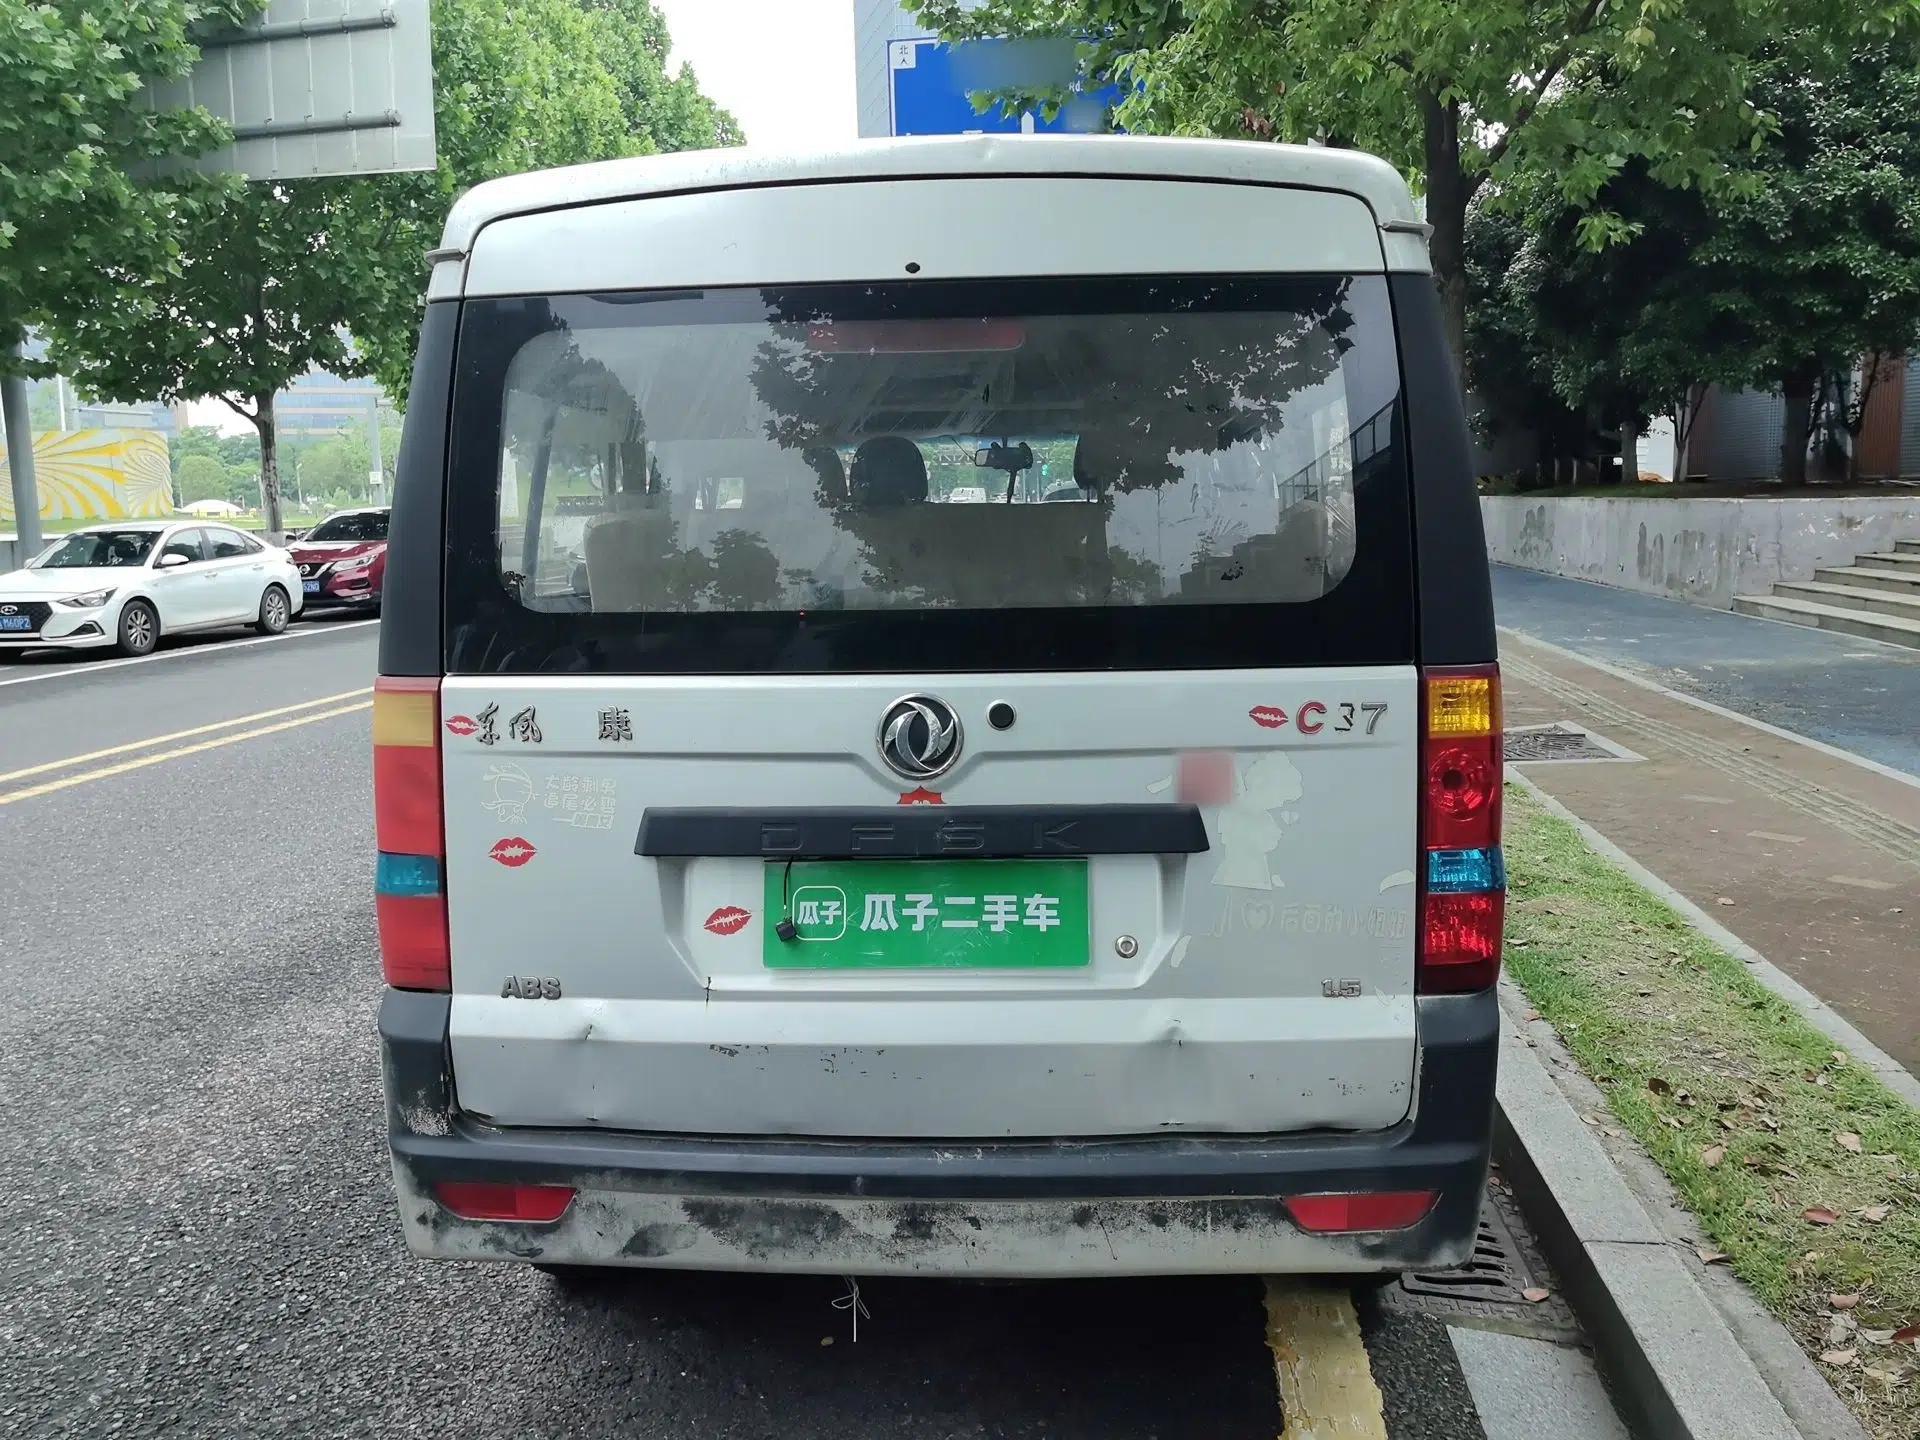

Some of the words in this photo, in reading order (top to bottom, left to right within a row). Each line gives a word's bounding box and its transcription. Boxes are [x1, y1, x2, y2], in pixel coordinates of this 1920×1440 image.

[760, 821, 1080, 852] DFSK
[797, 901, 842, 925] 瓜子
[860, 893, 1061, 932] 瓜子二手车
[501, 975, 562, 1000] ABS
